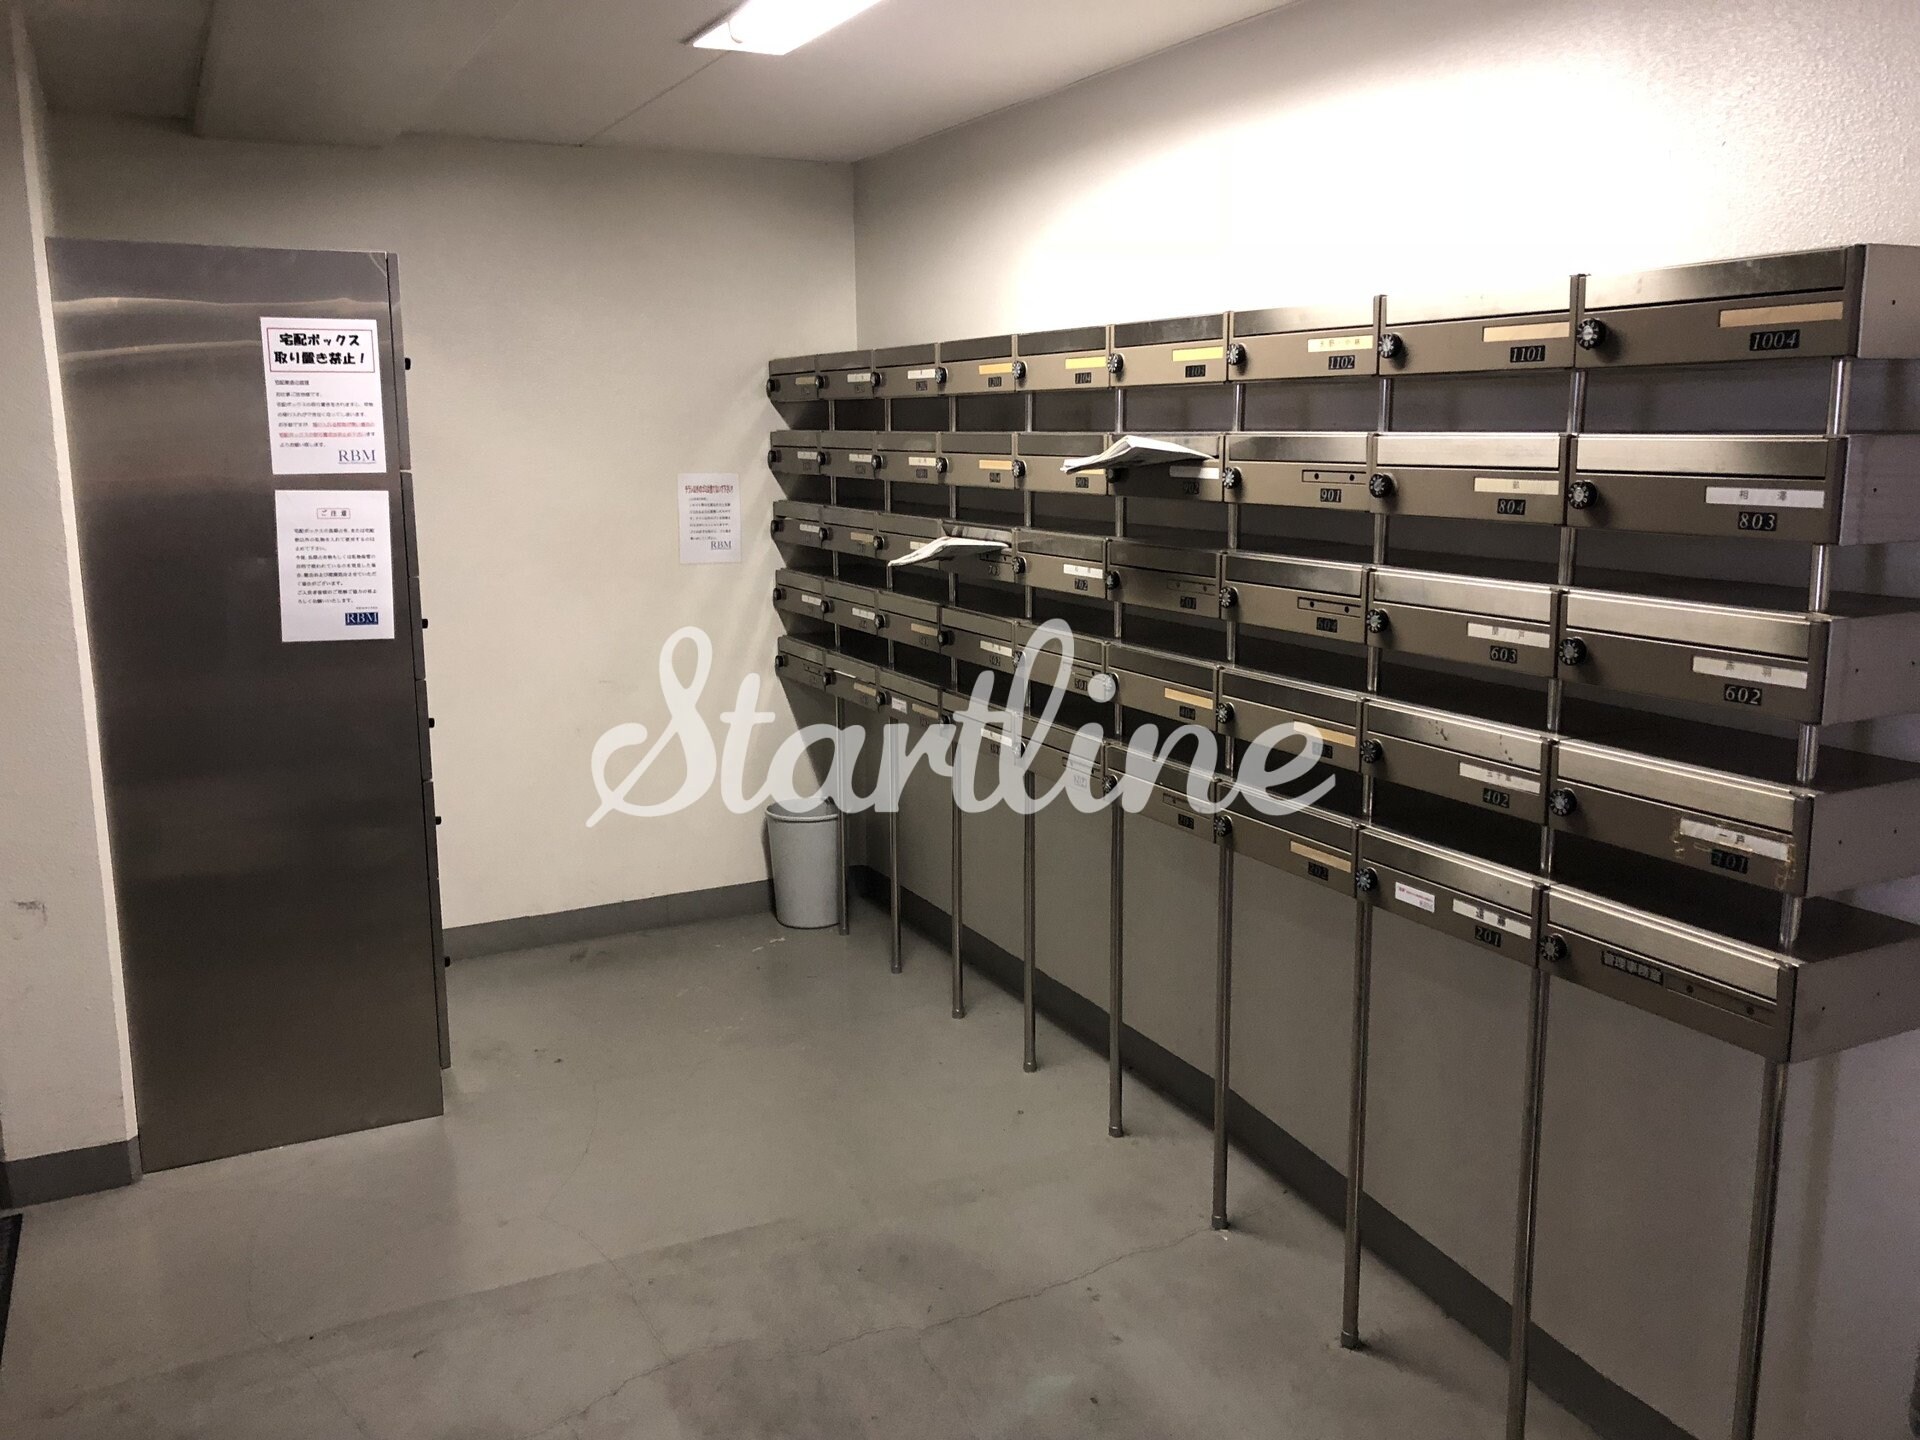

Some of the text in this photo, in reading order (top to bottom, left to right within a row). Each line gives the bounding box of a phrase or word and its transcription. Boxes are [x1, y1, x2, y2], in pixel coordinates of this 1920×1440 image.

[279, 333, 360, 346] 宅配ボックス
[1752, 332, 1797, 350] 1004
[1511, 345, 1544, 361] 1101
[1330, 356, 1354, 369] 1102
[338, 449, 377, 461] RBM
[1320, 489, 1340, 502] 901
[1498, 500, 1524, 514] 804
[1738, 513, 1776, 530] 803
[711, 541, 732, 550] RBM
[346, 613, 378, 623] RBM
[1491, 647, 1517, 662] 603
[1725, 686, 1761, 704] 602
[1484, 789, 1509, 807] 402
[1476, 926, 1500, 946] 201
